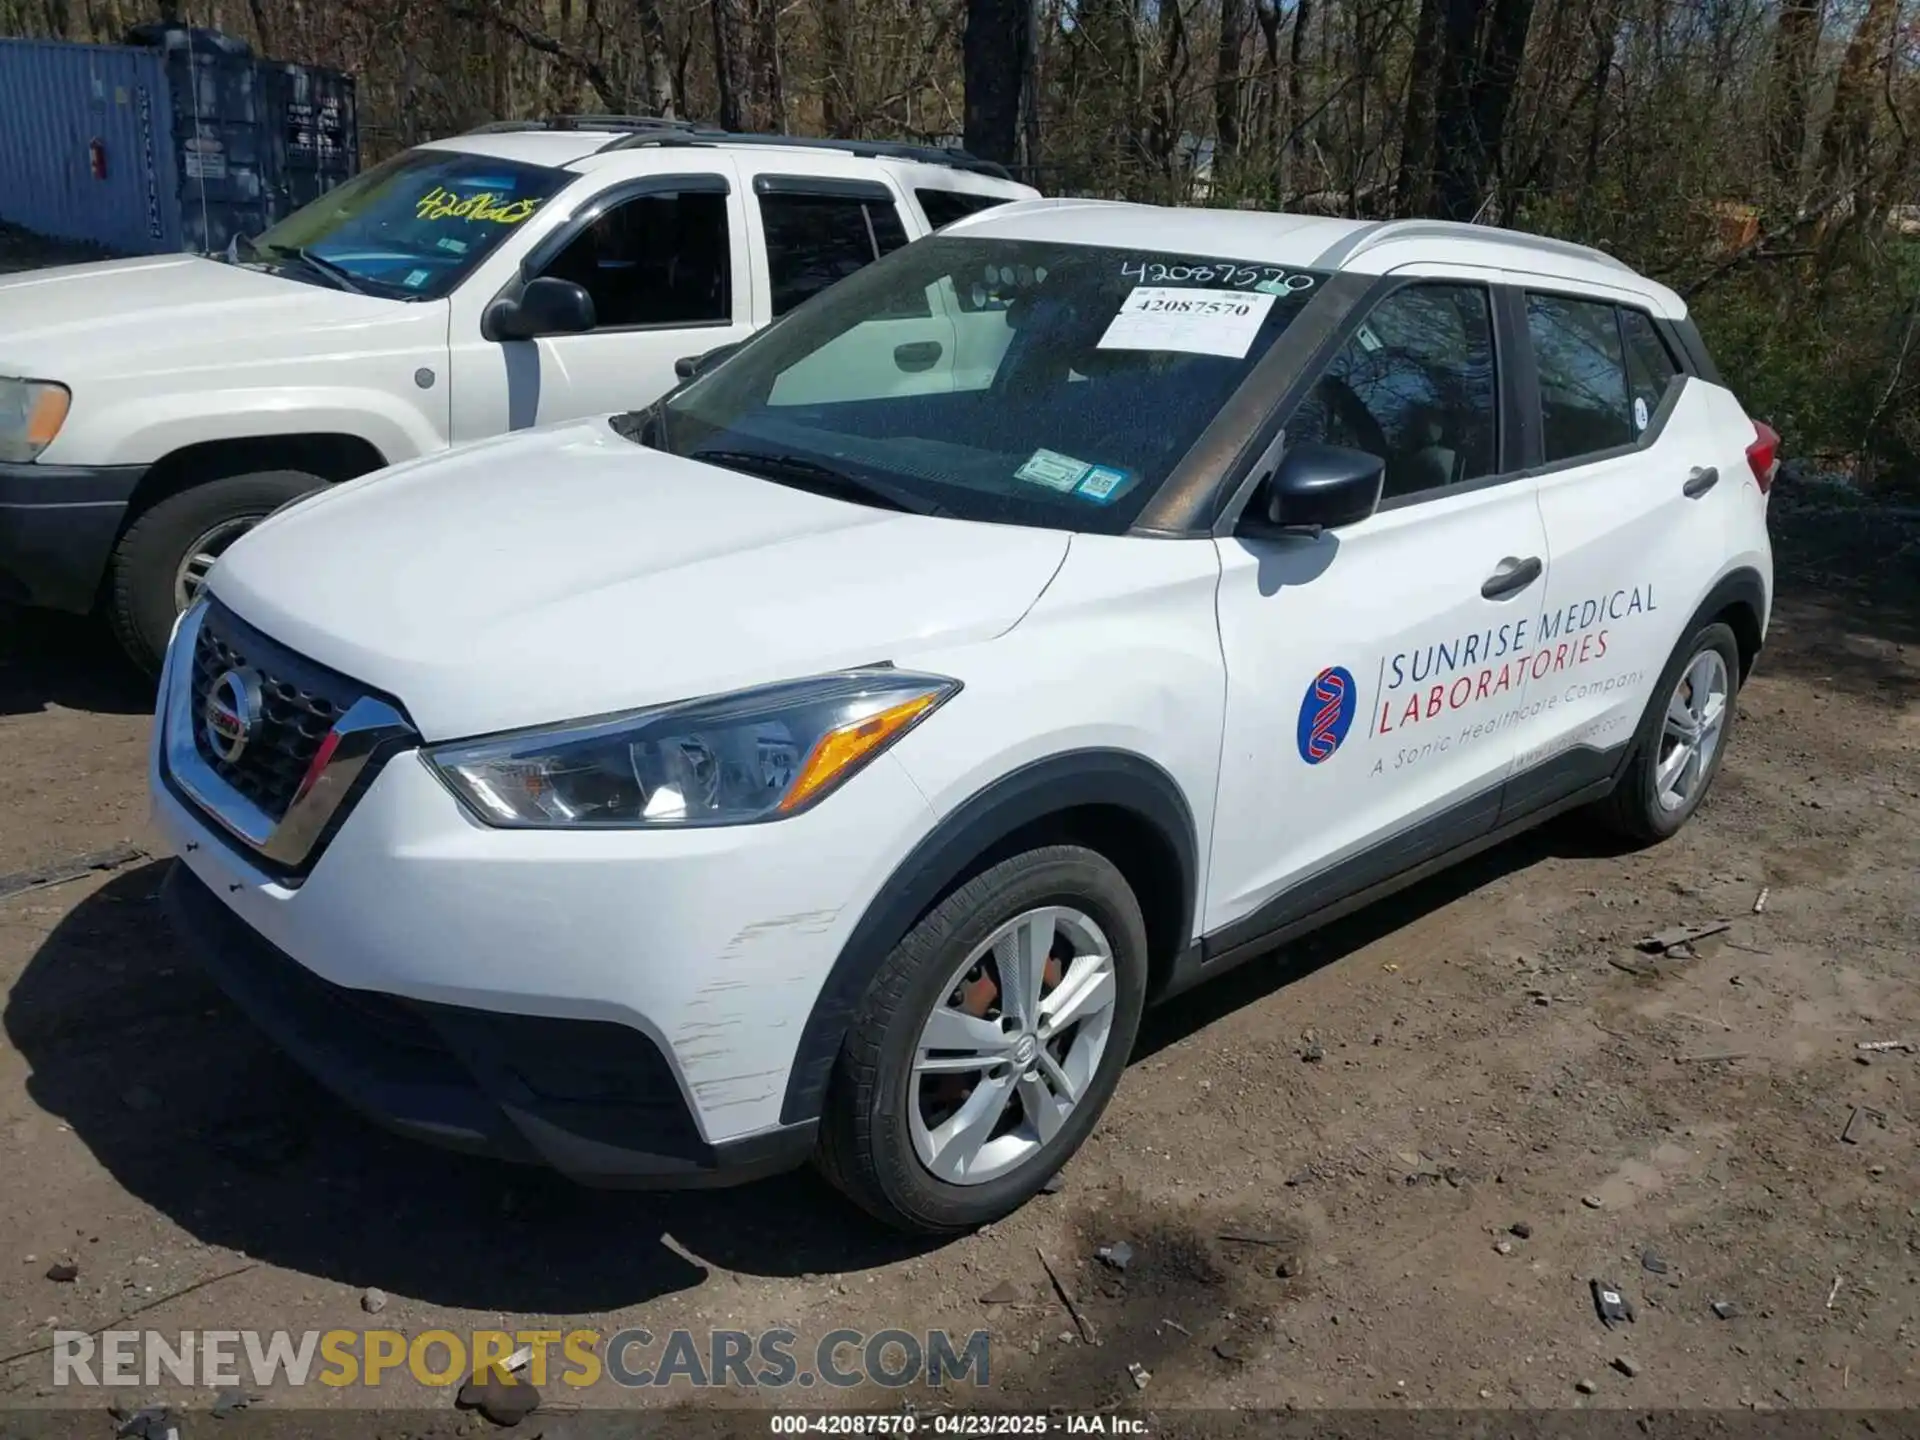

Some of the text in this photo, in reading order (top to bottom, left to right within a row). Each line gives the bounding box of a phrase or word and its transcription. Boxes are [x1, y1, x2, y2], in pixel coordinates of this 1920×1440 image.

[1120, 261, 1315, 291] 42087570
[1135, 300, 1250, 317] 42087570
[1378, 629, 1610, 735] LABORATORIES
[1388, 583, 1658, 690] SUNRISE MEDICAL
[1370, 760, 1384, 778] A
[1394, 734, 1453, 770] Sonic
[1458, 693, 1555, 745] Healthcare
[1565, 670, 1646, 703] Company
